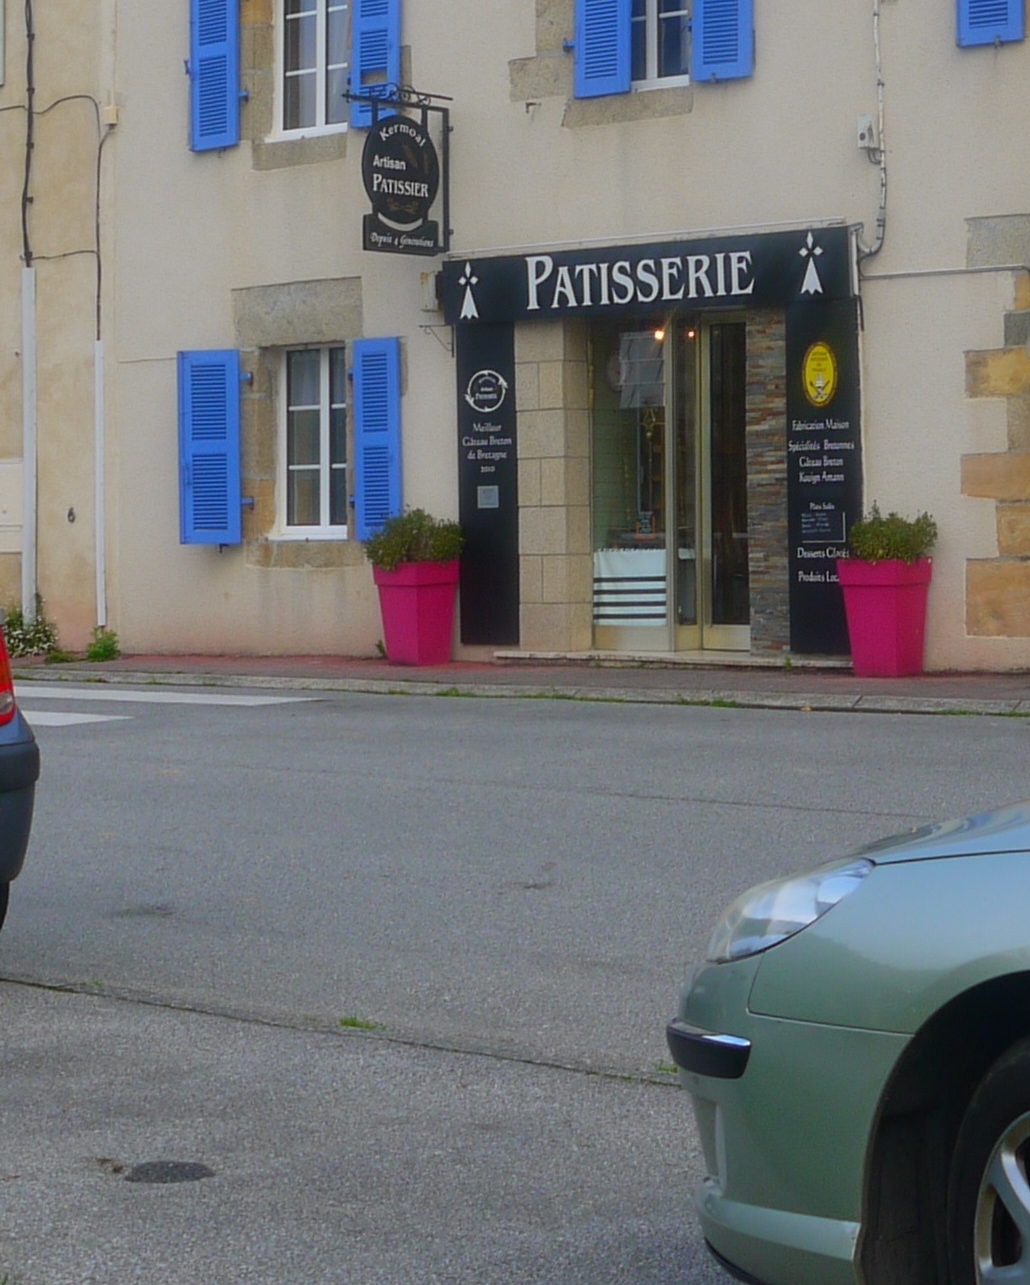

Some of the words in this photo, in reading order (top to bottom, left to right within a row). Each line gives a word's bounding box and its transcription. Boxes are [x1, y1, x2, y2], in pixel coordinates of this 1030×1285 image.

[379, 123, 426, 147] Kermoal
[372, 154, 406, 171] Artisan
[372, 173, 429, 197] PATISSIER
[525, 250, 755, 310] PATISSERIE
[473, 422, 502, 433] Meilleur
[792, 420, 824, 431] Fabrication
[826, 419, 850, 429] Maison
[467, 450, 476, 460] de
[823, 455, 844, 466] Breton
[799, 471, 821, 485] Kouign
[822, 471, 845, 482] Amann
[797, 547, 826, 558] Desserts
[798, 571, 825, 582] Produits
